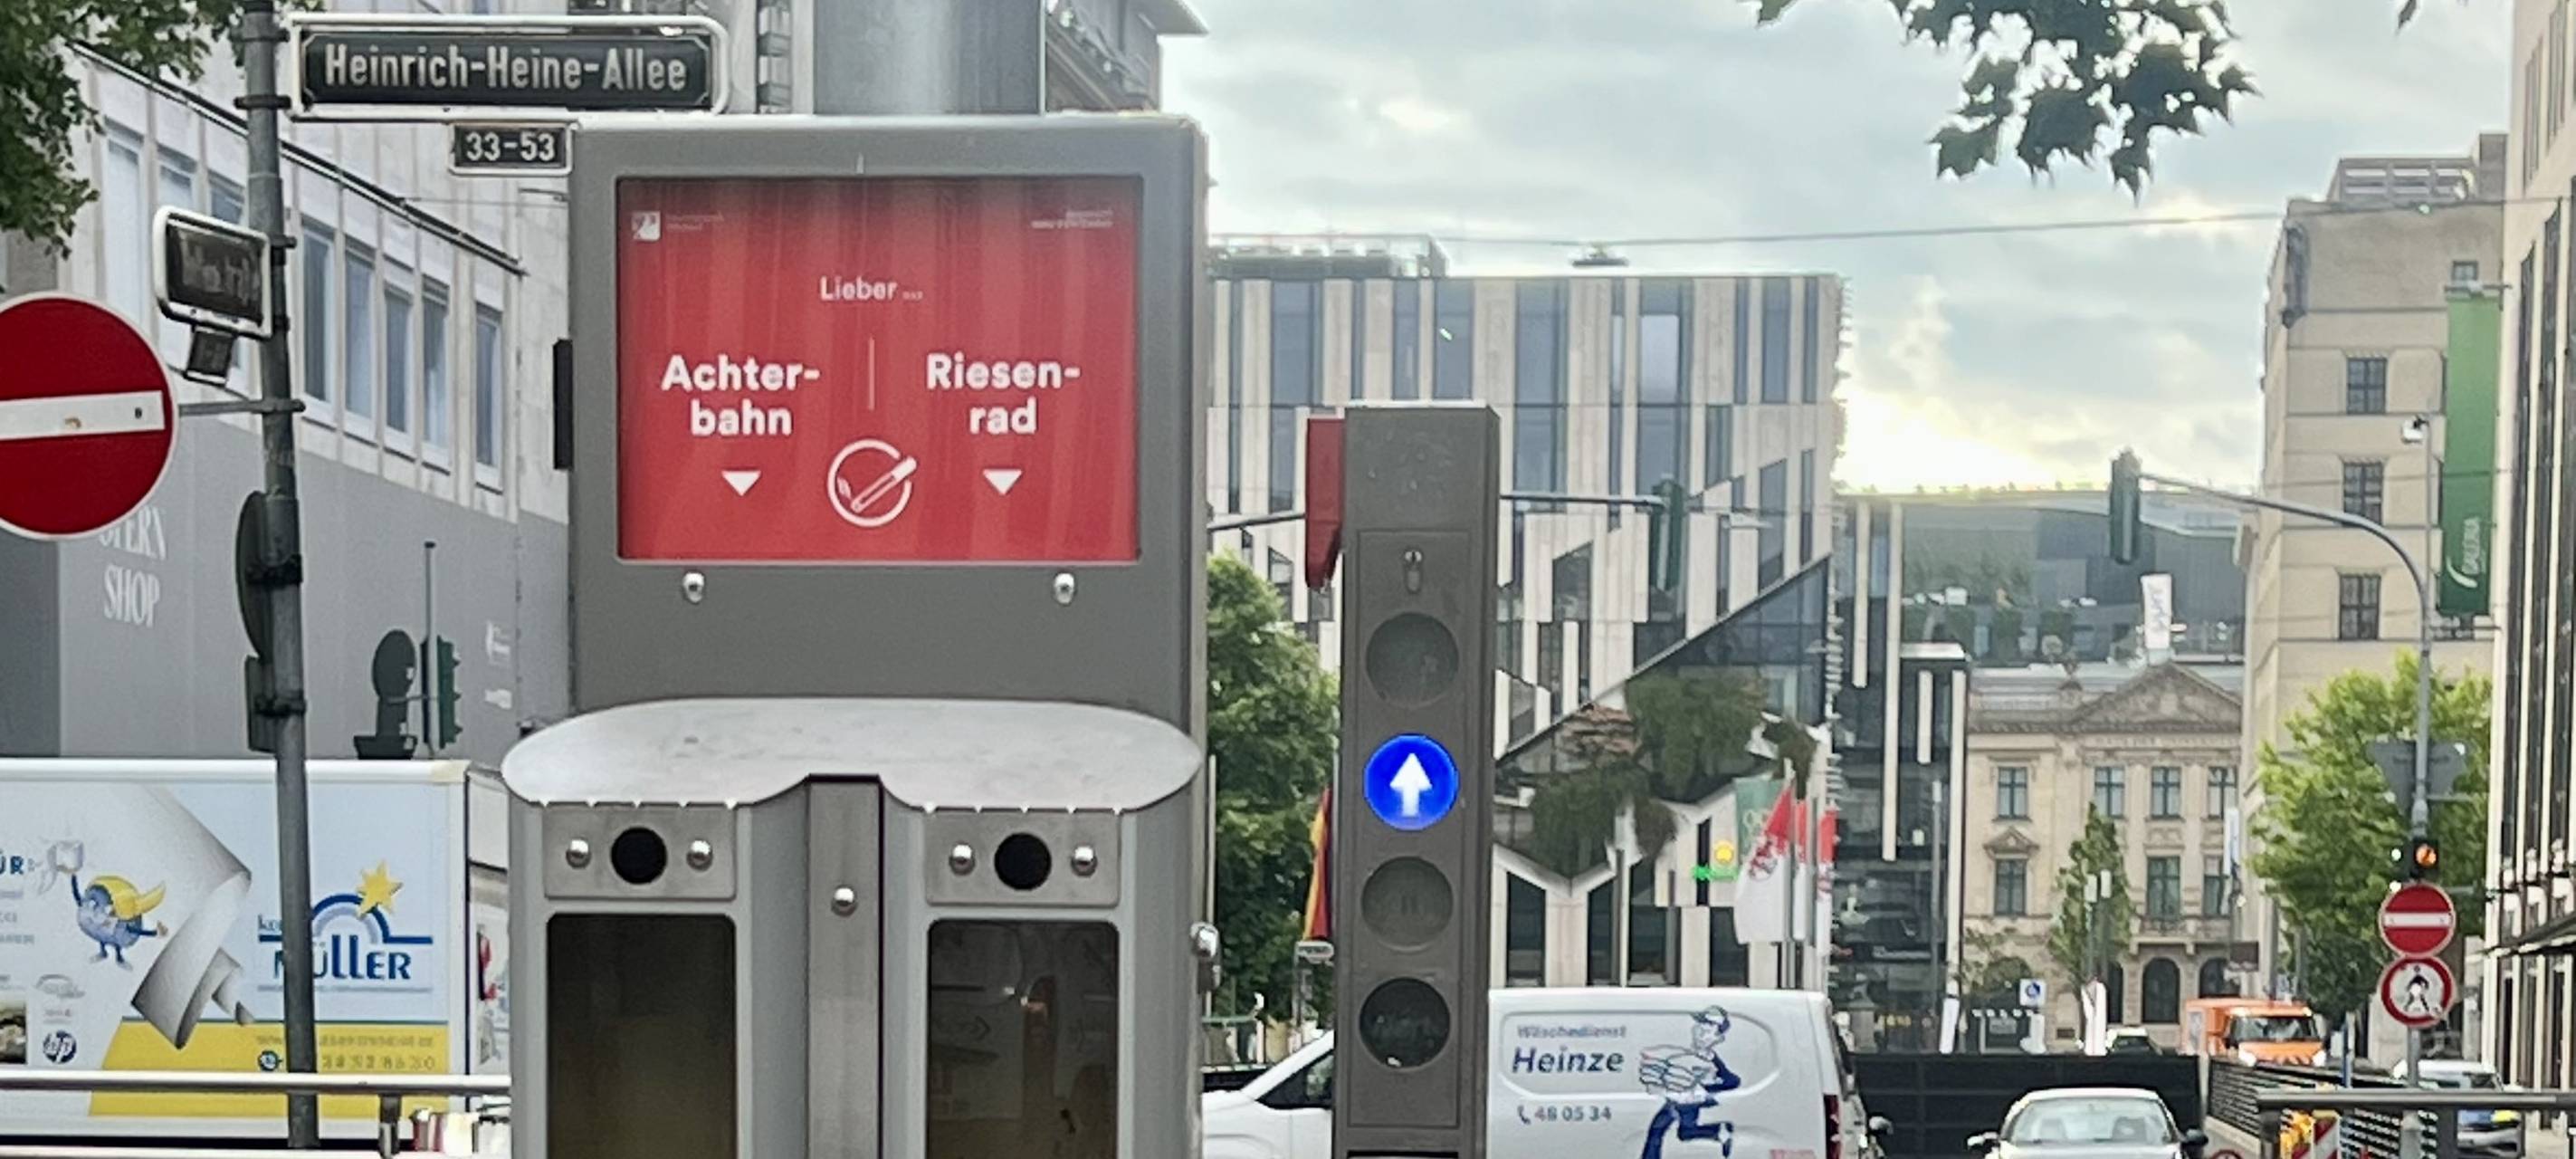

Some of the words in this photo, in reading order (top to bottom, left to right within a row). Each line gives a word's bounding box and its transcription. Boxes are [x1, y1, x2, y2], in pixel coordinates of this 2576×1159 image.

[324, 43, 688, 91] Heinrich-Heine-Allee
[465, 132, 556, 162] 33-53
[819, 274, 898, 301] Lieber
[660, 352, 821, 392] Achter-
[925, 350, 1081, 390] Riesen-
[690, 398, 793, 436] bahn
[968, 396, 1038, 436] rad
[104, 562, 160, 628] SHOP
[1511, 1045, 1625, 1074] Heinze
[1534, 1106, 1558, 1122] 48
[1561, 1106, 1585, 1122] 05
[1589, 1106, 1613, 1122] 34
